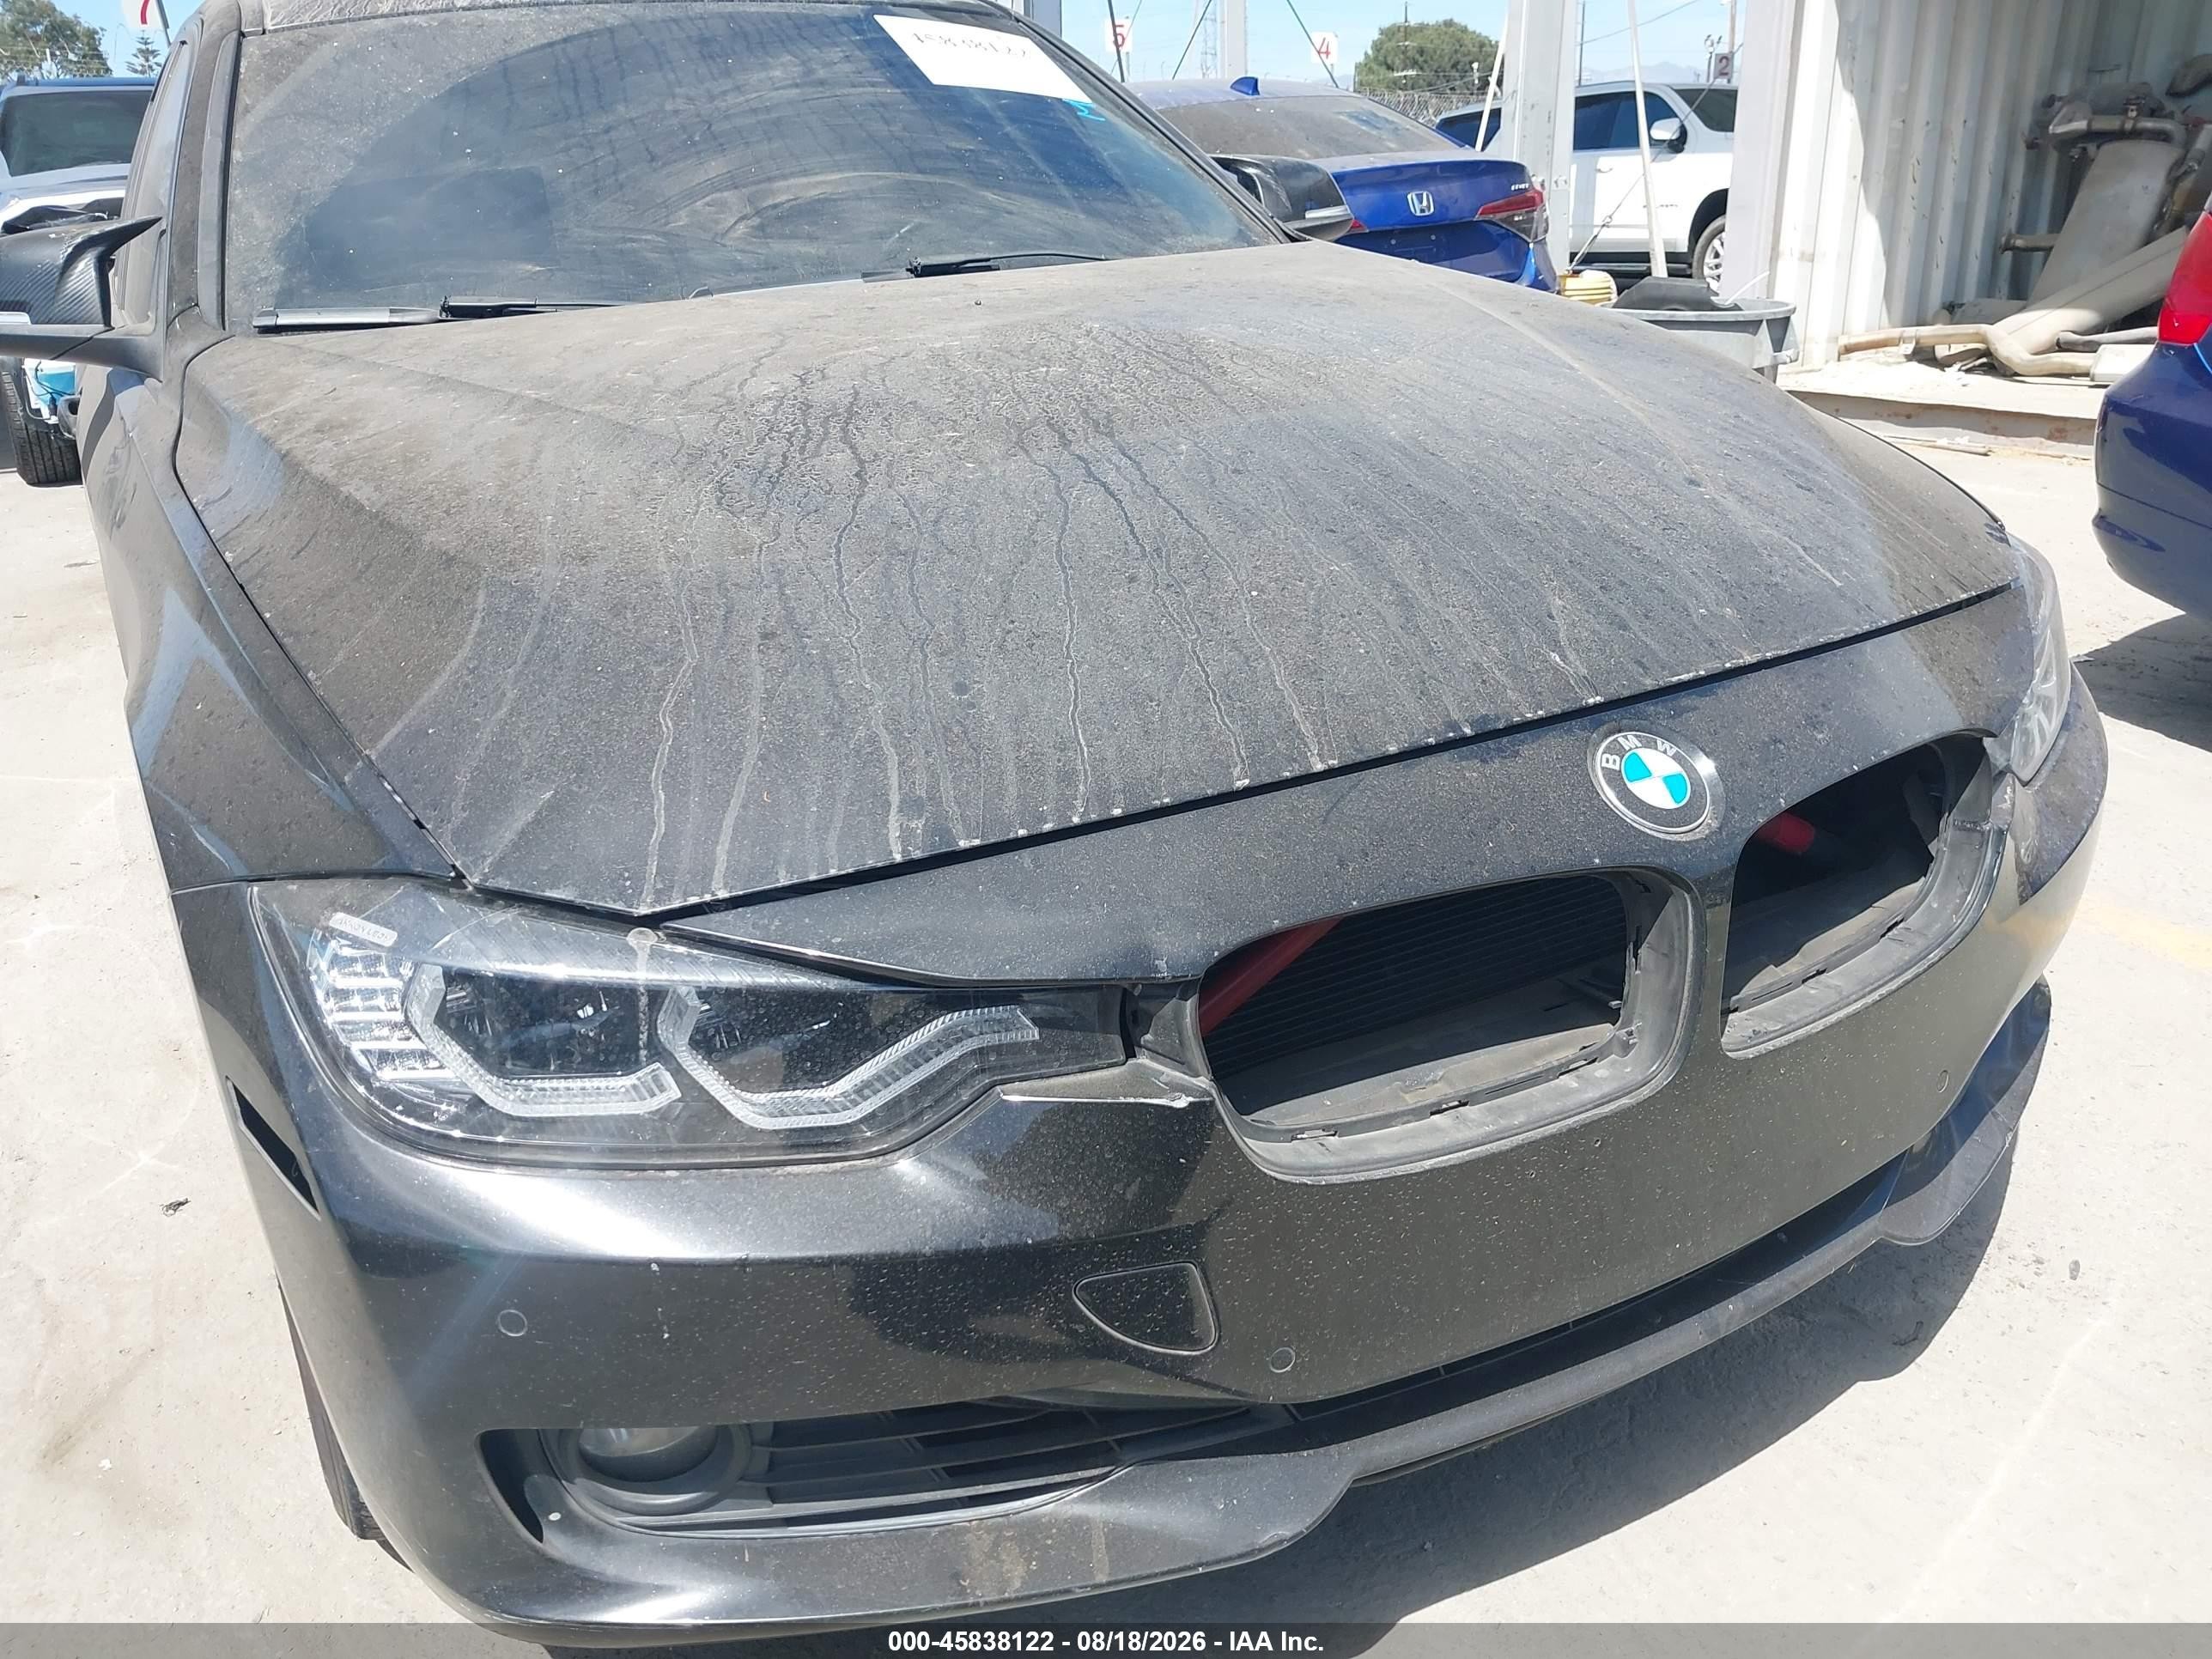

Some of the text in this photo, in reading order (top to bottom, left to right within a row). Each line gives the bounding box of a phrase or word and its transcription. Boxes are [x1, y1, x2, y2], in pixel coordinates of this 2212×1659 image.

[1113, 24, 1126, 49] 5
[1318, 37, 1331, 59] 4
[1719, 55, 1729, 76] 2
[1601, 734, 1677, 770] BMW
